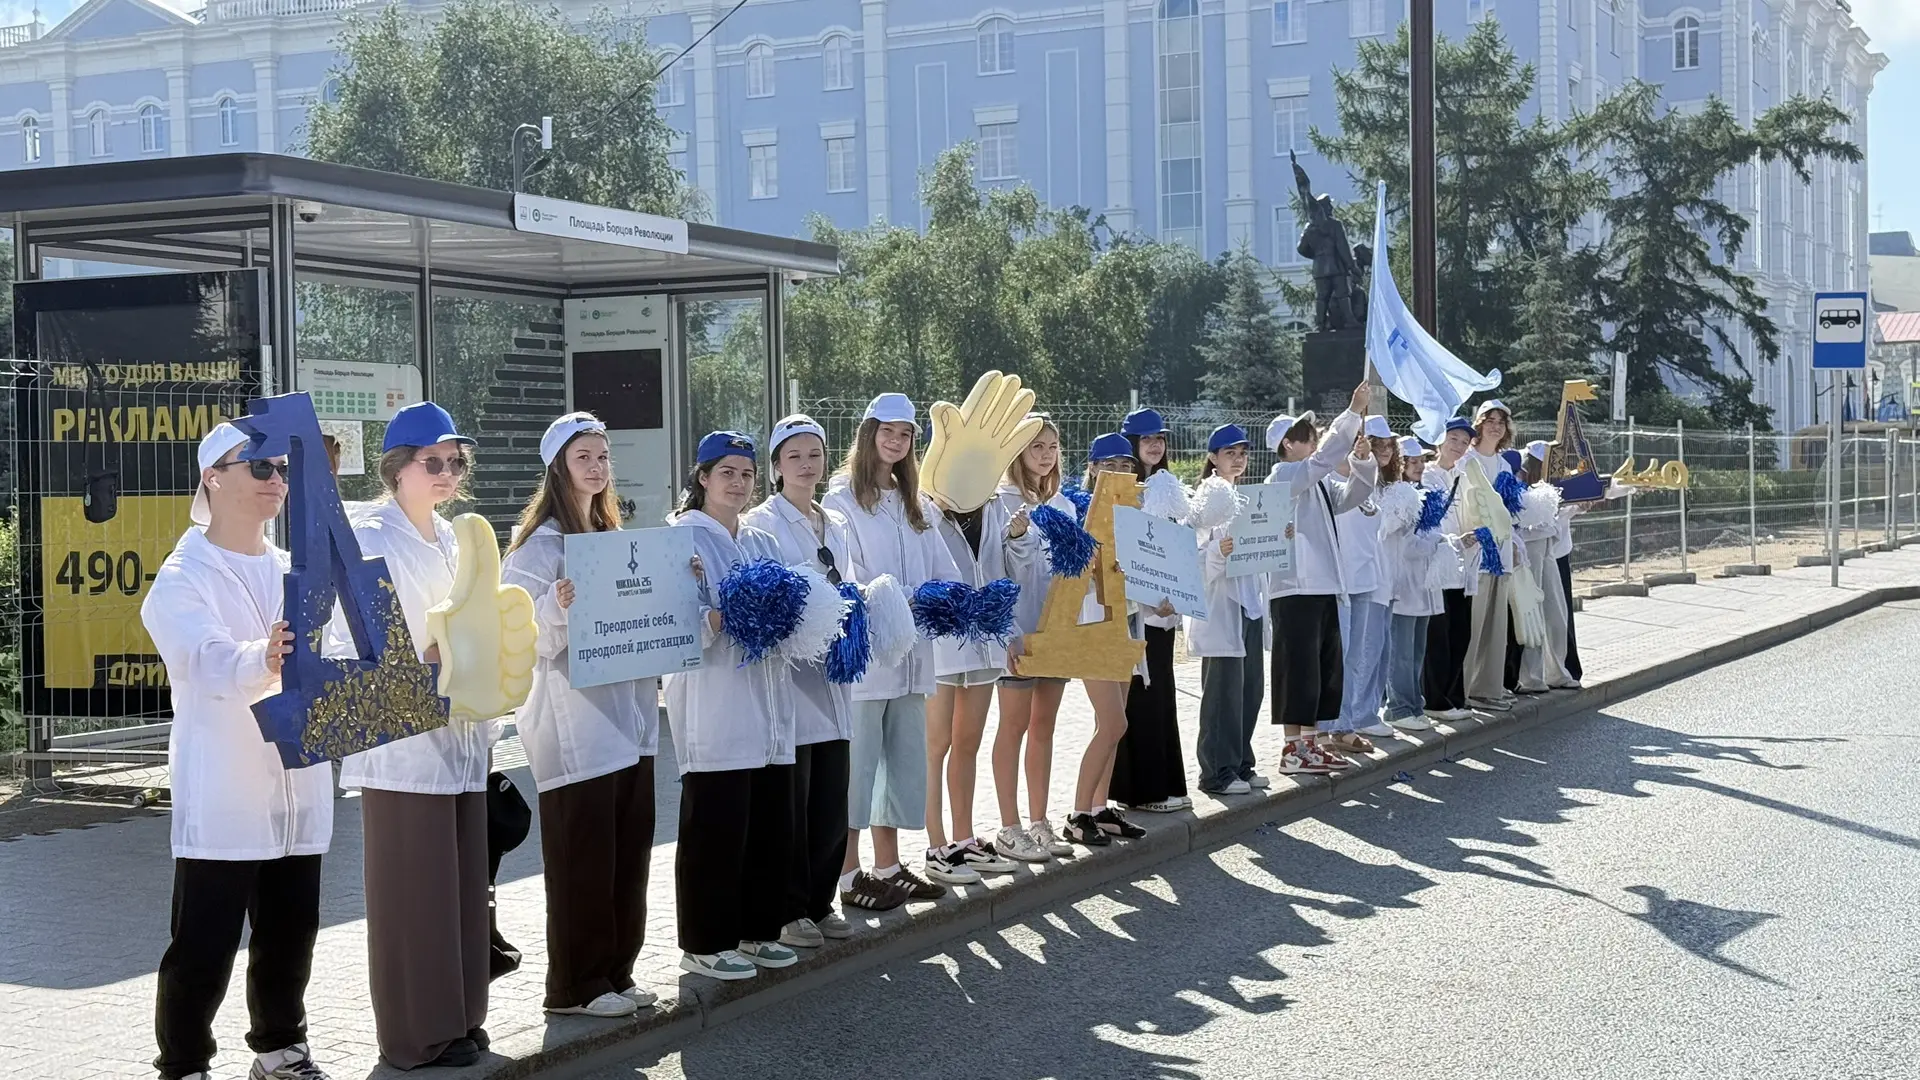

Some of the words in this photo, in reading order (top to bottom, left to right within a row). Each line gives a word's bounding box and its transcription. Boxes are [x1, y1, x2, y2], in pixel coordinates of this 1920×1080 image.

[569, 215, 605, 233] Площадь
[606, 221, 633, 237] Борцов
[634, 223, 674, 242] Революции
[53, 364, 120, 386] МЕСО
[124, 363, 165, 388] ДЛЯ
[170, 359, 240, 382] ВАШЕЙ
[55, 550, 173, 596] 490-
[1131, 560, 1178, 582] Победители
[1160, 584, 1170, 594] на
[1172, 588, 1198, 602] старте
[594, 614, 650, 637] Преодолей
[652, 612, 677, 627] себя,
[578, 639, 634, 662] преодолей
[636, 634, 695, 654] дистанцию
[108, 661, 170, 687] ДРИ
